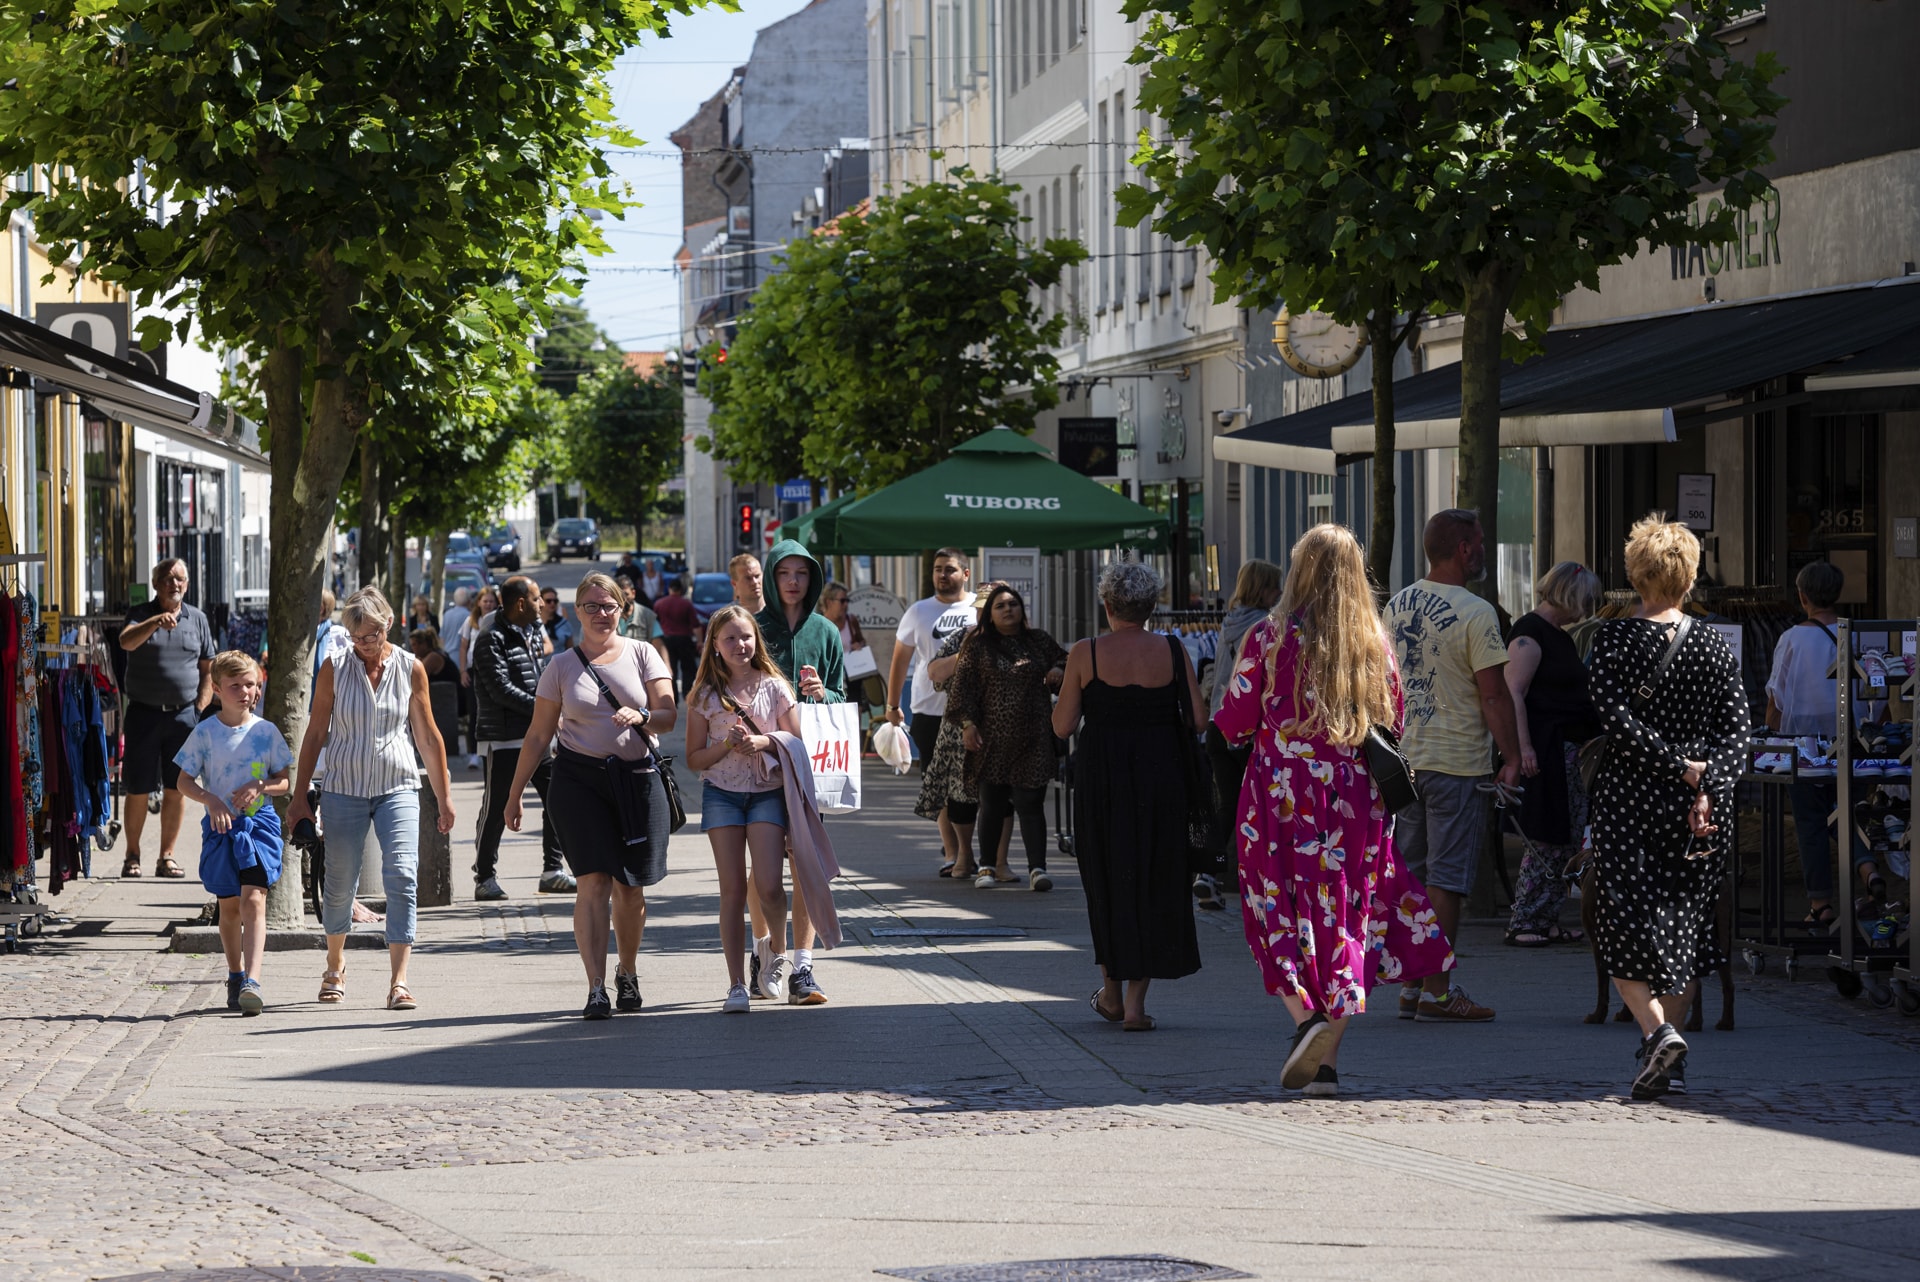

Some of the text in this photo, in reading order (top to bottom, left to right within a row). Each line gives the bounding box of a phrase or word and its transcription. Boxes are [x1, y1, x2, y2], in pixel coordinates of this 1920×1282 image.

[944, 493, 1061, 510] TUBORG
[1820, 508, 1864, 527] 365
[1389, 588, 1459, 633] YAKUZA
[856, 614, 898, 626] ANINO
[938, 614, 968, 627] NIKE
[1872, 677, 1883, 685] 24
[811, 739, 849, 773] H&M
